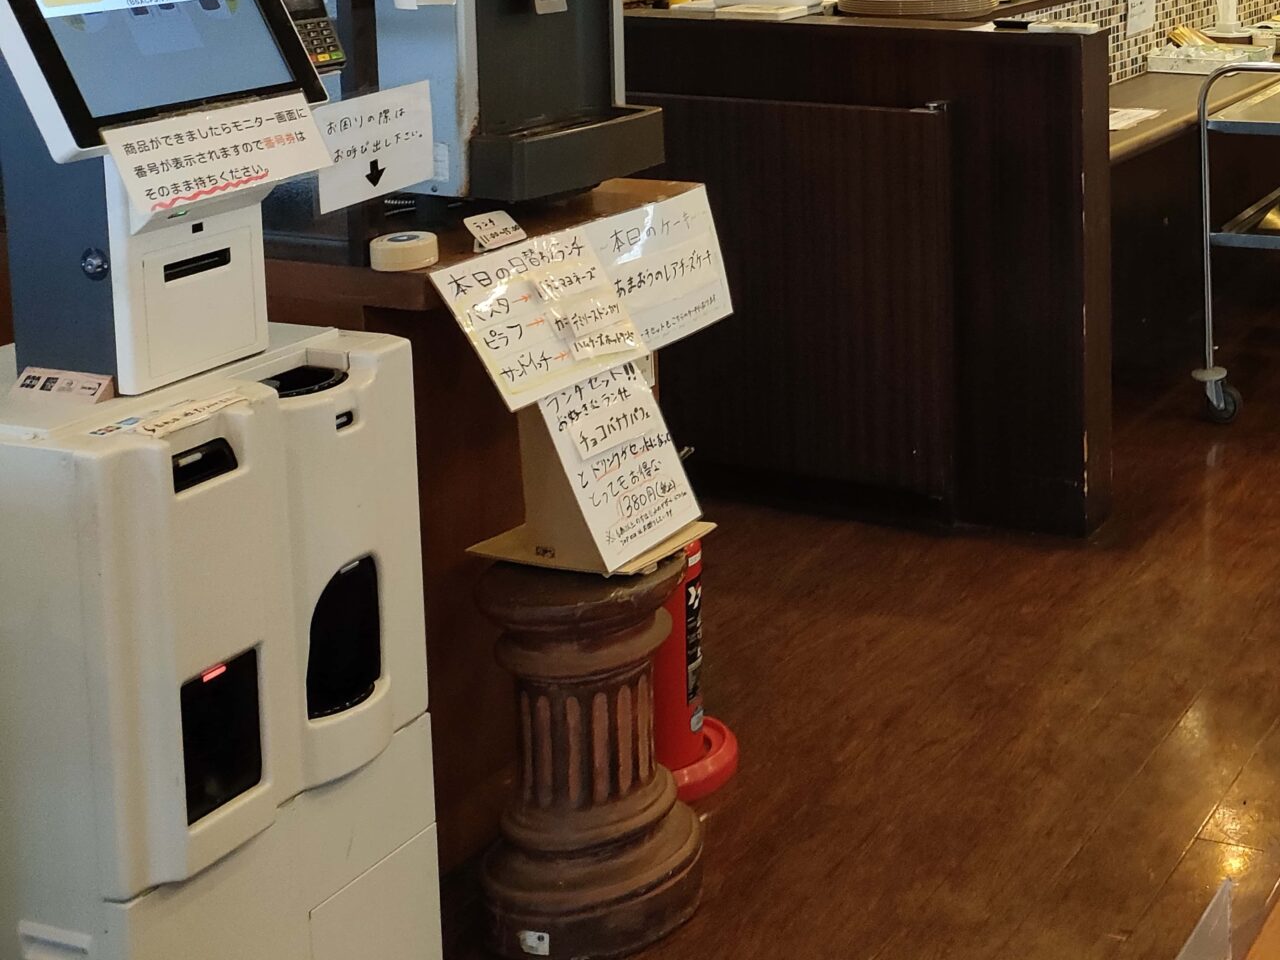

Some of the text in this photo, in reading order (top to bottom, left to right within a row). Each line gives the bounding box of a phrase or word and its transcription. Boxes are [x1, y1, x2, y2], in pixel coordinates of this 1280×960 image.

[122, 107, 308, 156] 商品ができましたらモニター画面に
[326, 108, 406, 136] お困りの際は
[133, 130, 307, 179] 番号が表示されますので番号券は
[144, 163, 270, 200] そのまま待ちください。
[482, 322, 524, 350] ピラフ
[499, 350, 553, 382] サンドイッチ
[579, 406, 651, 452] チョコバナナパフェ
